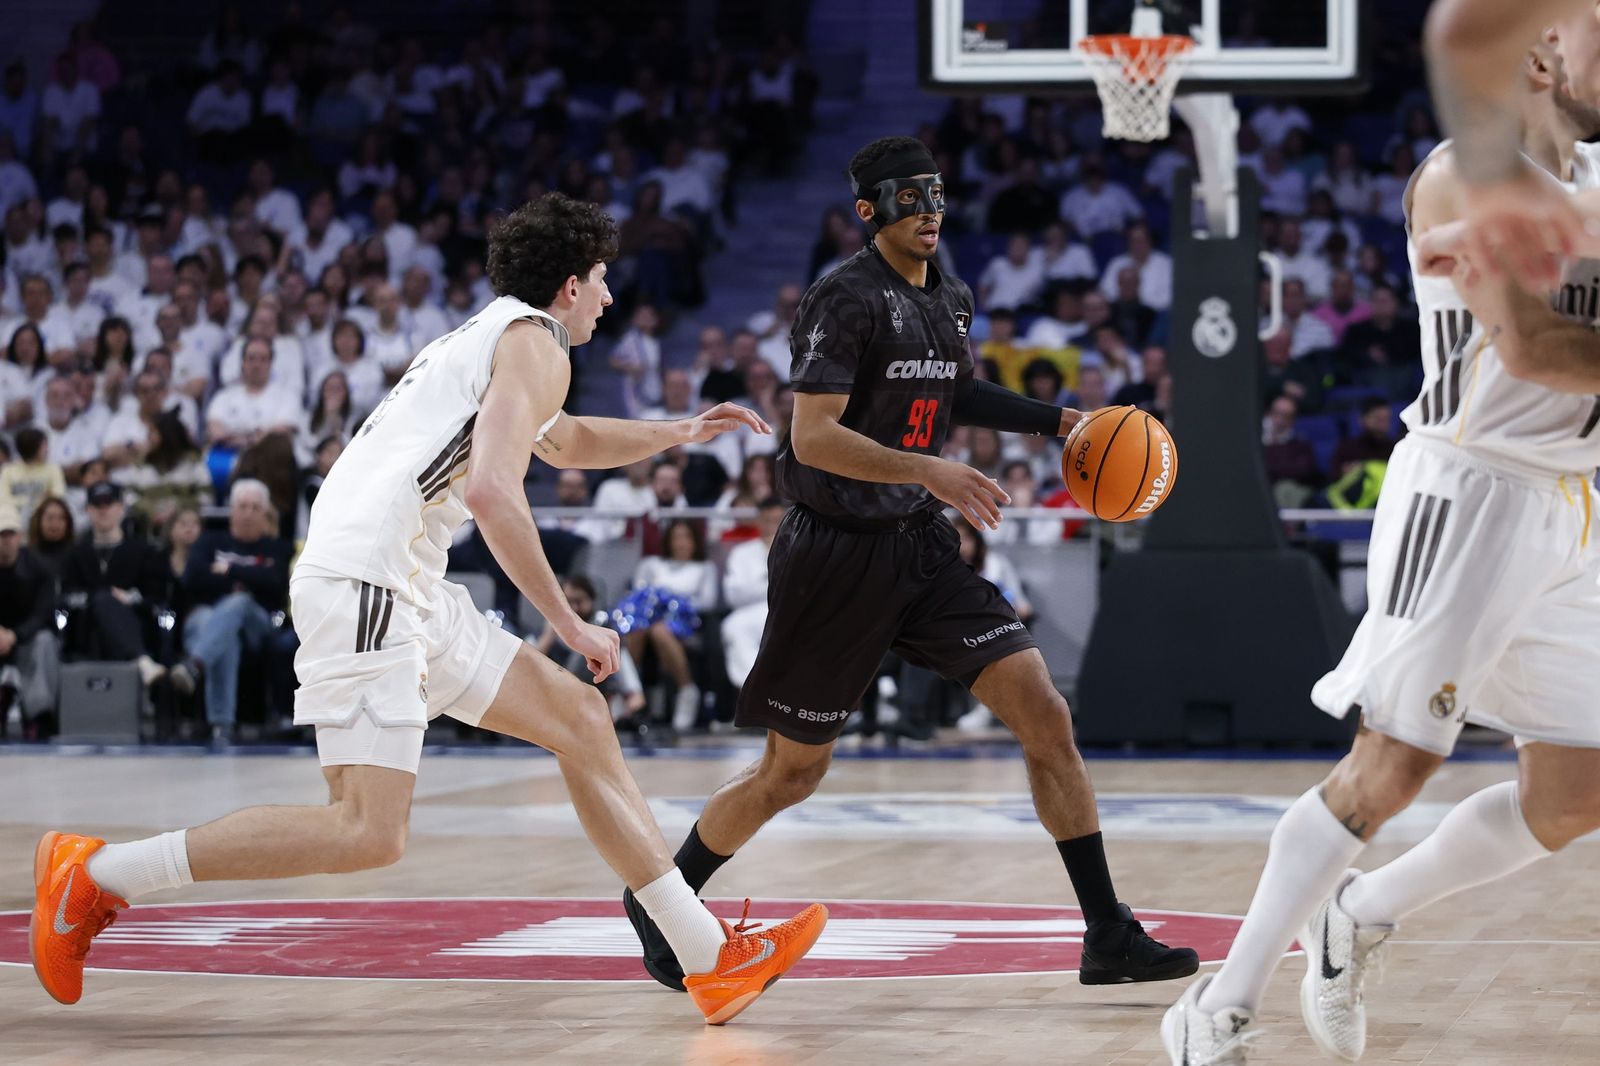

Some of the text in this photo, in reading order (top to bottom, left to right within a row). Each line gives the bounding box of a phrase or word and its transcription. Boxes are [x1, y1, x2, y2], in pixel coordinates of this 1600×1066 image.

[885, 349, 959, 379] COVIRA
[902, 399, 939, 448] 93
[1075, 440, 1091, 471] acb
[1134, 441, 1170, 513] Wilson
[767, 698, 839, 723] vive asisa
